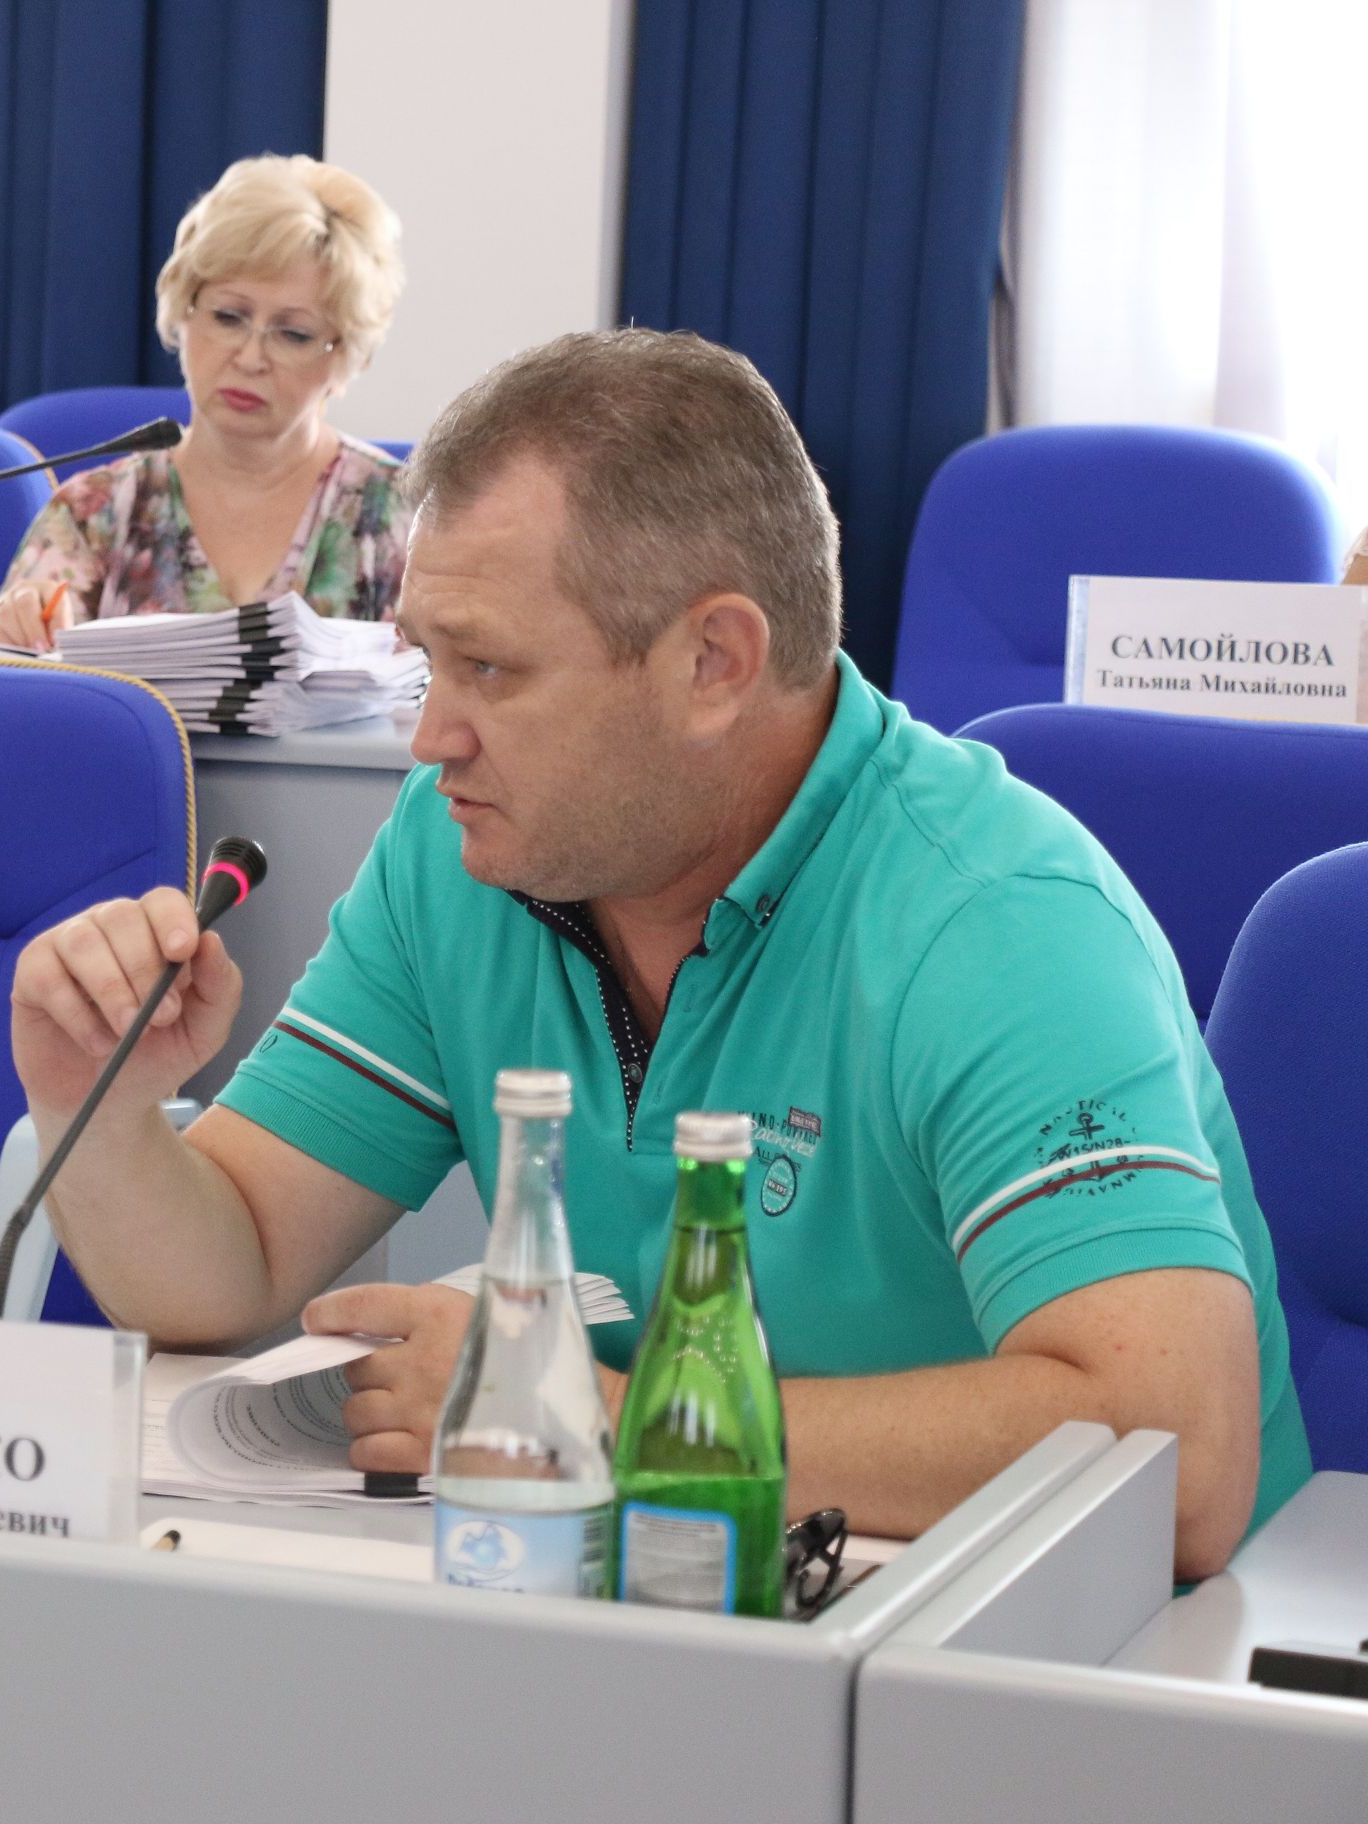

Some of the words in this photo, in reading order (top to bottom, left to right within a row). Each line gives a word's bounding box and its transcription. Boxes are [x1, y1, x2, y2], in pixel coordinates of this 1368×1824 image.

[1110, 633, 1335, 667] САМОЙЛОВА
[1096, 669, 1191, 691] Татьяна
[1199, 674, 1347, 698] Михайловна
